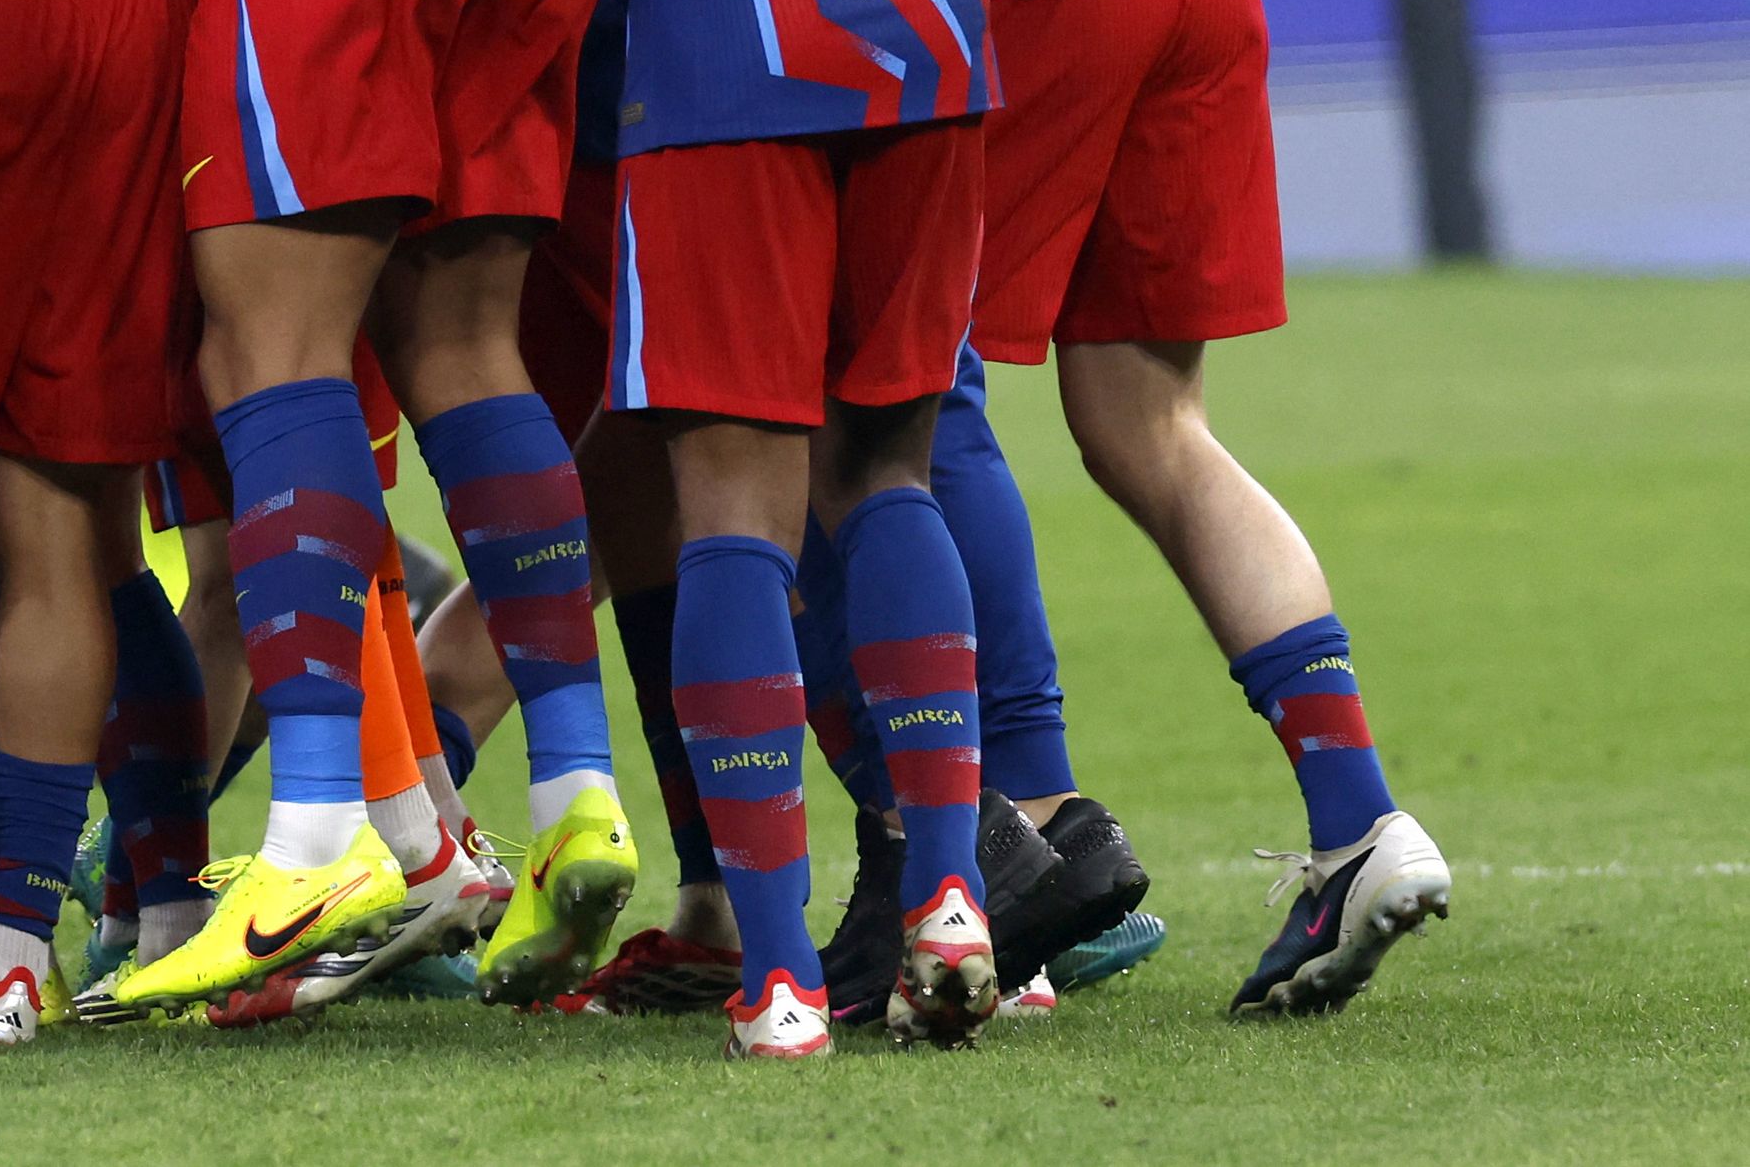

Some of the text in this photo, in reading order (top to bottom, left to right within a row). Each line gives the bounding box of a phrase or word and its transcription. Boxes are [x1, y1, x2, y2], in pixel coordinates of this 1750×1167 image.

[515, 539, 586, 572] BARÇA
[889, 709, 963, 732] BARÇA
[712, 751, 789, 773] BARÇA
